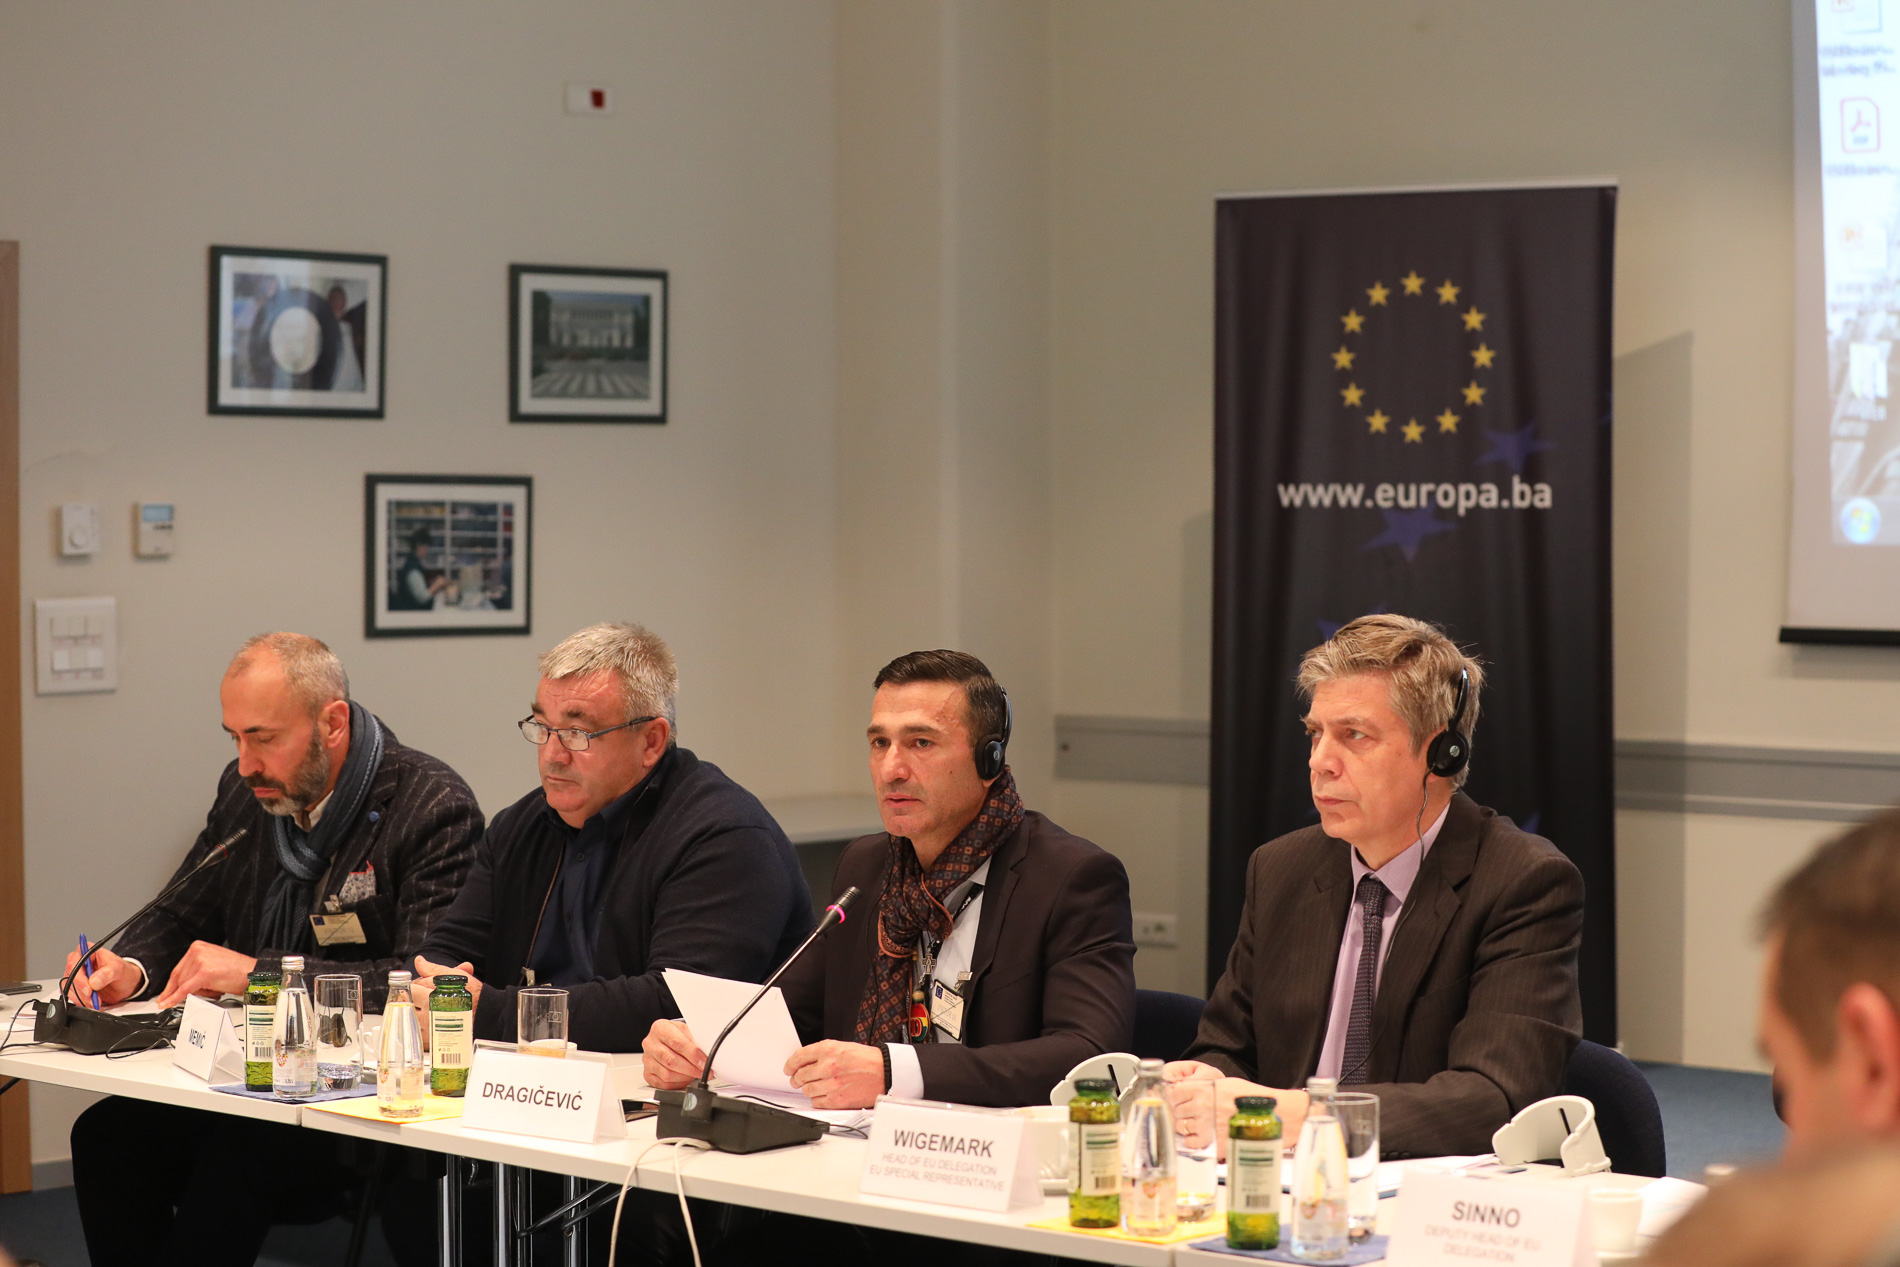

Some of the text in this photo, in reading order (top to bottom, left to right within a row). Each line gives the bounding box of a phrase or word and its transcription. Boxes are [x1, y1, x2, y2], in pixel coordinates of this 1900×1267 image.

[1277, 474, 1552, 517] www.europa.ba
[482, 1082, 583, 1111] DRAGIČEVIĆ
[894, 1129, 994, 1158] WIGEMARK
[869, 1165, 1005, 1191] EU SPECIAL REPRESENTATIVE
[882, 1153, 998, 1176] HEAD OF EU DELEGATION
[1452, 1200, 1520, 1228] SINNO
[1442, 1241, 1516, 1263] DELEGATION
